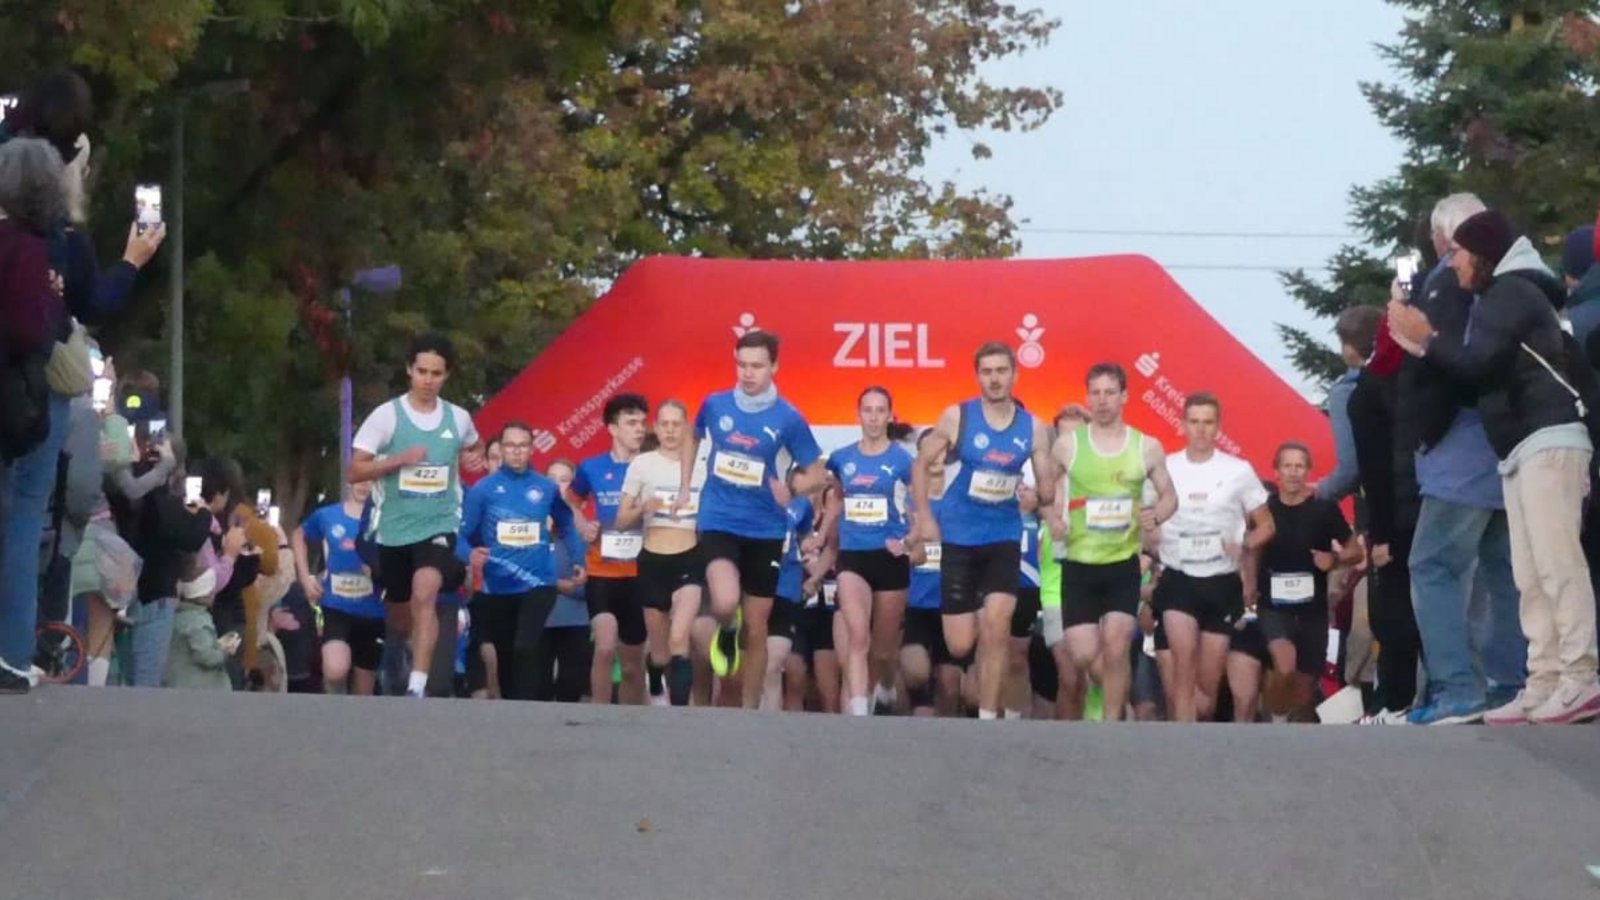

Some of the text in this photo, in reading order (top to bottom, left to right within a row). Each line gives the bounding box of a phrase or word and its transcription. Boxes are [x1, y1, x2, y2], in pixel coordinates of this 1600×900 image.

[832, 322, 946, 367] ZIEL
[556, 356, 644, 435] Kreissparkasse
[727, 459, 750, 471] 475
[413, 468, 439, 479] 422
[854, 500, 875, 510] 474
[509, 524, 529, 534] 594
